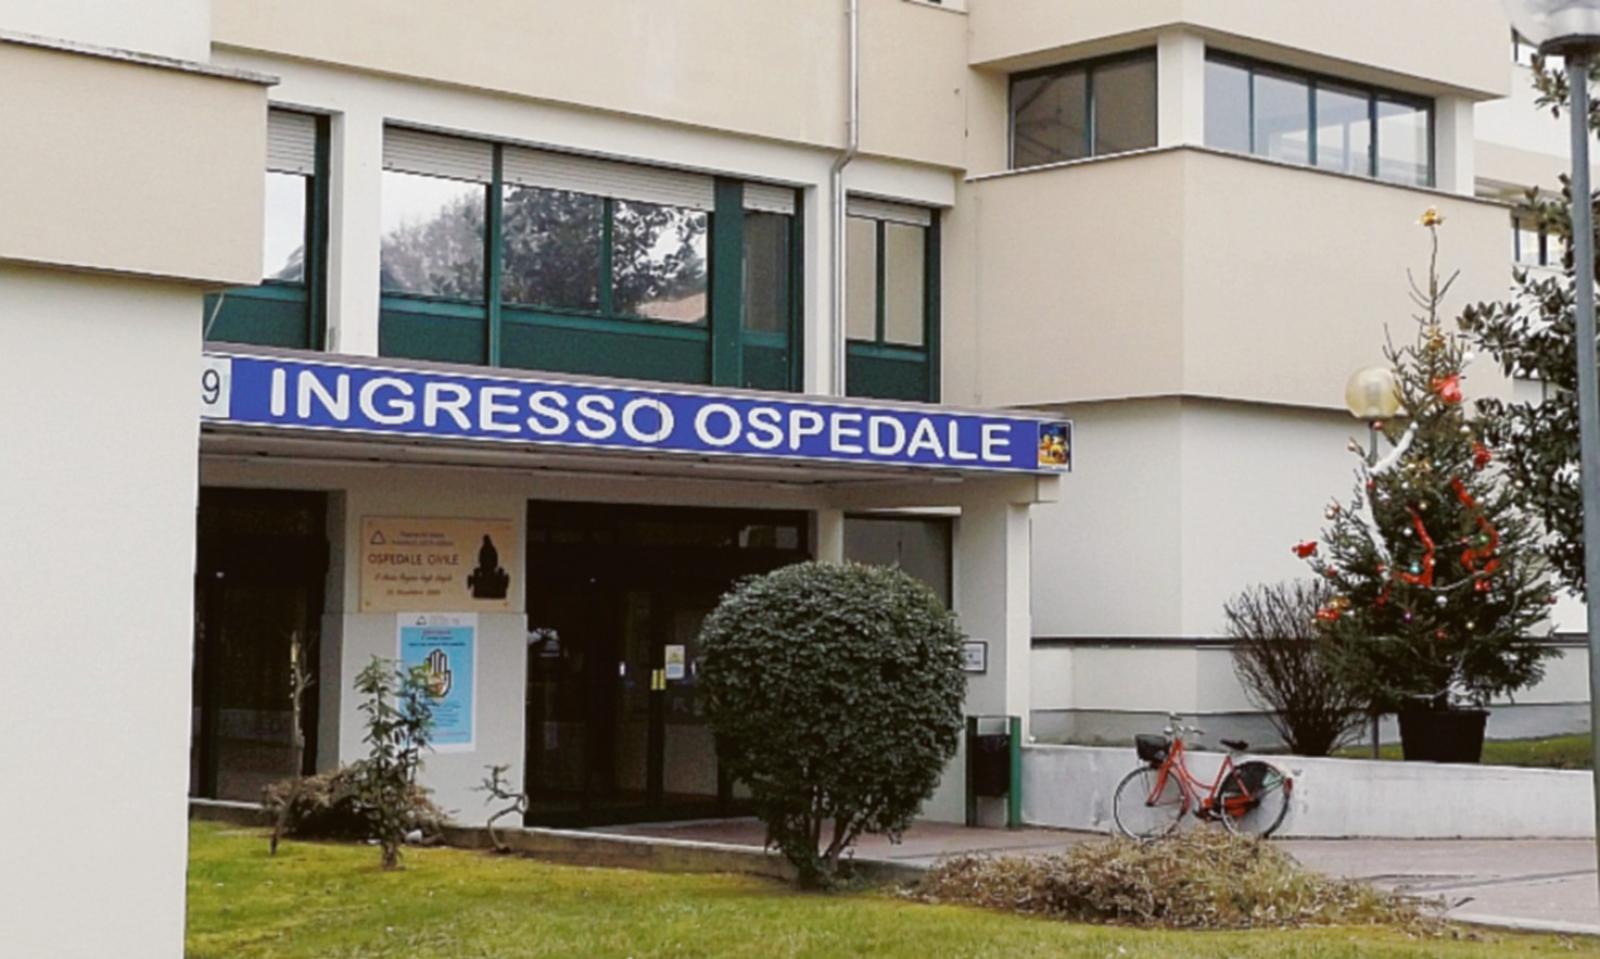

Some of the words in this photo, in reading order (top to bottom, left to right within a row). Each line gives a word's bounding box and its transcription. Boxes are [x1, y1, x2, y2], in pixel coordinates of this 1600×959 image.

[270, 368, 675, 443] INGRESSO
[694, 403, 1012, 462] OSPEDALE
[368, 553, 422, 566] OSPEDALE
